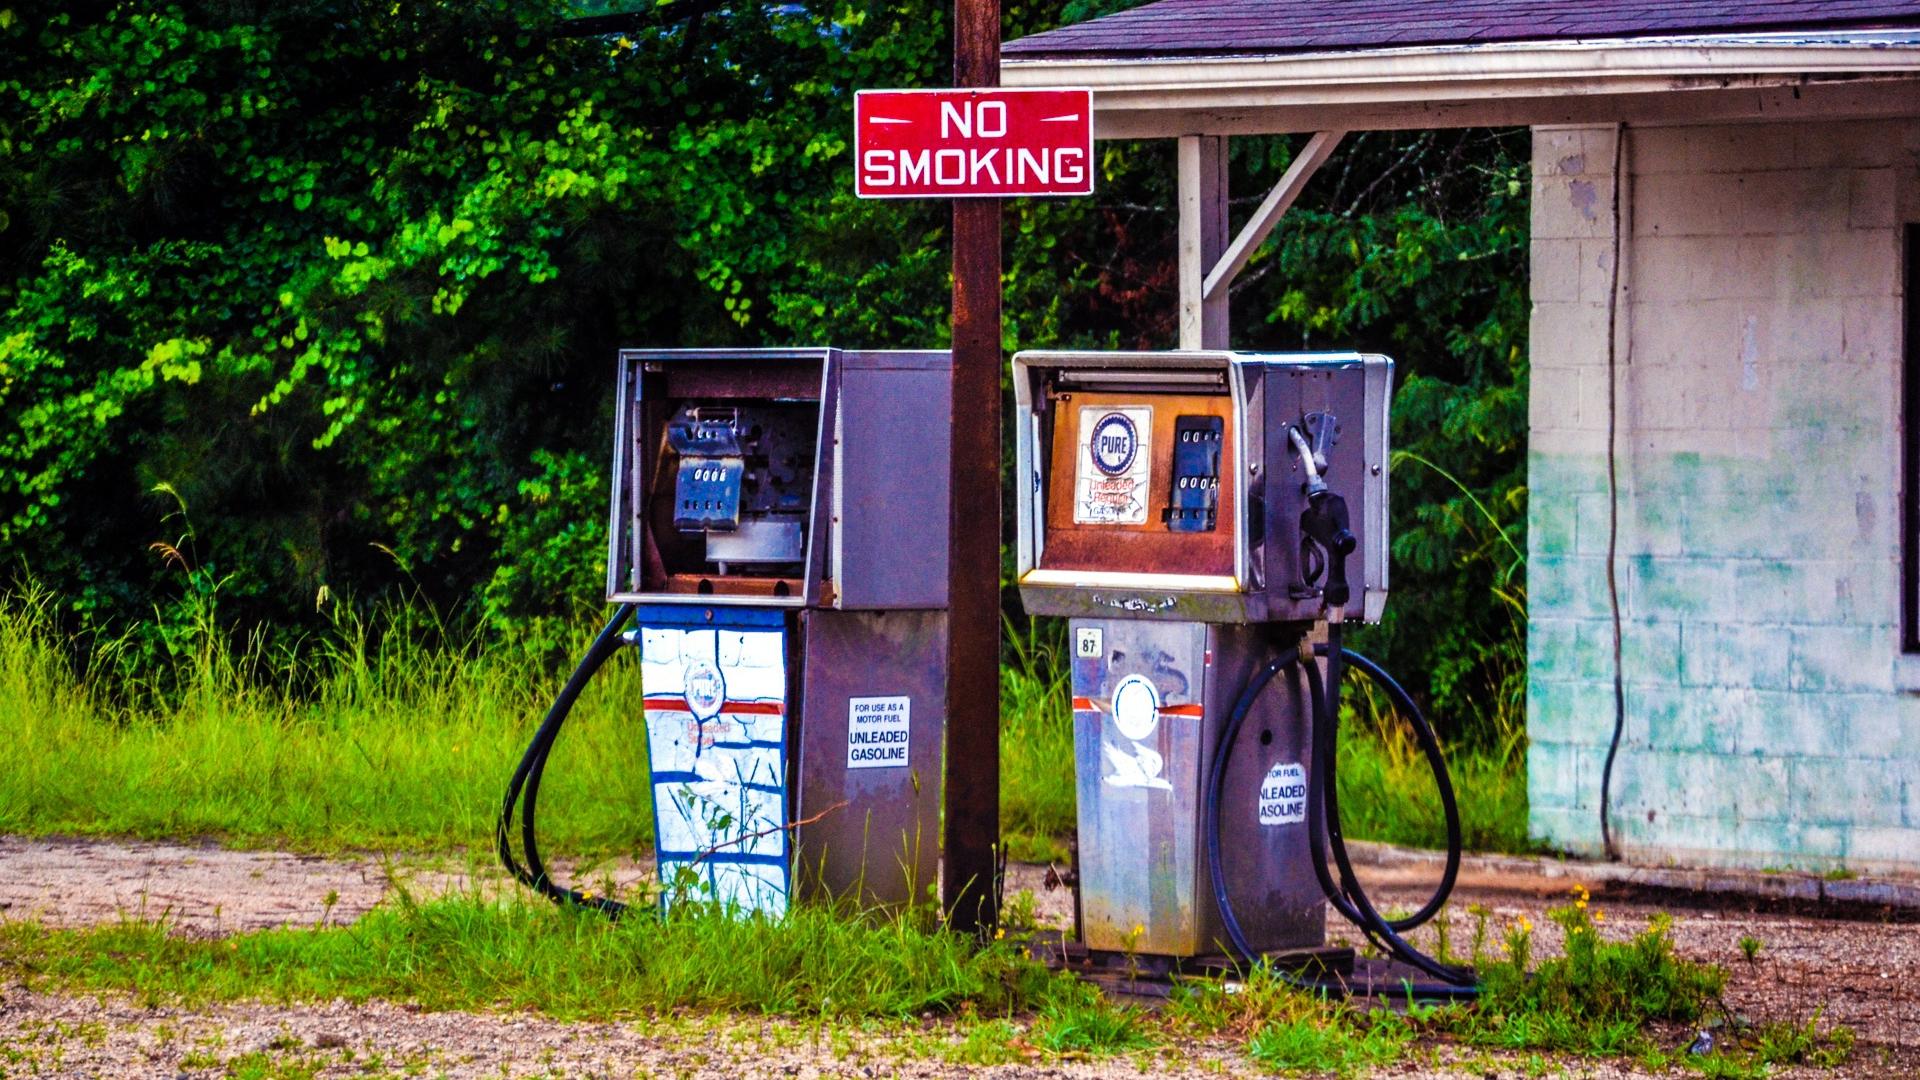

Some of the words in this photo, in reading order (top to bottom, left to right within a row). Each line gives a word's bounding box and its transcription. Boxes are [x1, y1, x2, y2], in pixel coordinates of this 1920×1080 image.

[941, 101, 1007, 138] NO
[864, 148, 1084, 186] SMOKING
[1101, 436, 1128, 454] PURE
[1090, 479, 1134, 491] Unleaded
[1093, 491, 1129, 505] Regular
[1083, 639, 1096, 653] 87
[855, 704, 869, 712] FOR
[871, 703, 886, 712] USE
[888, 703, 897, 711] AS
[899, 703, 904, 711] A
[856, 714, 882, 724] MOTOR
[884, 714, 901, 723] FUEL
[687, 719, 730, 734] Uneaded
[850, 730, 908, 744] UNLEADED
[851, 747, 905, 761] GASOLINE
[1283, 768, 1300, 778] FUEL
